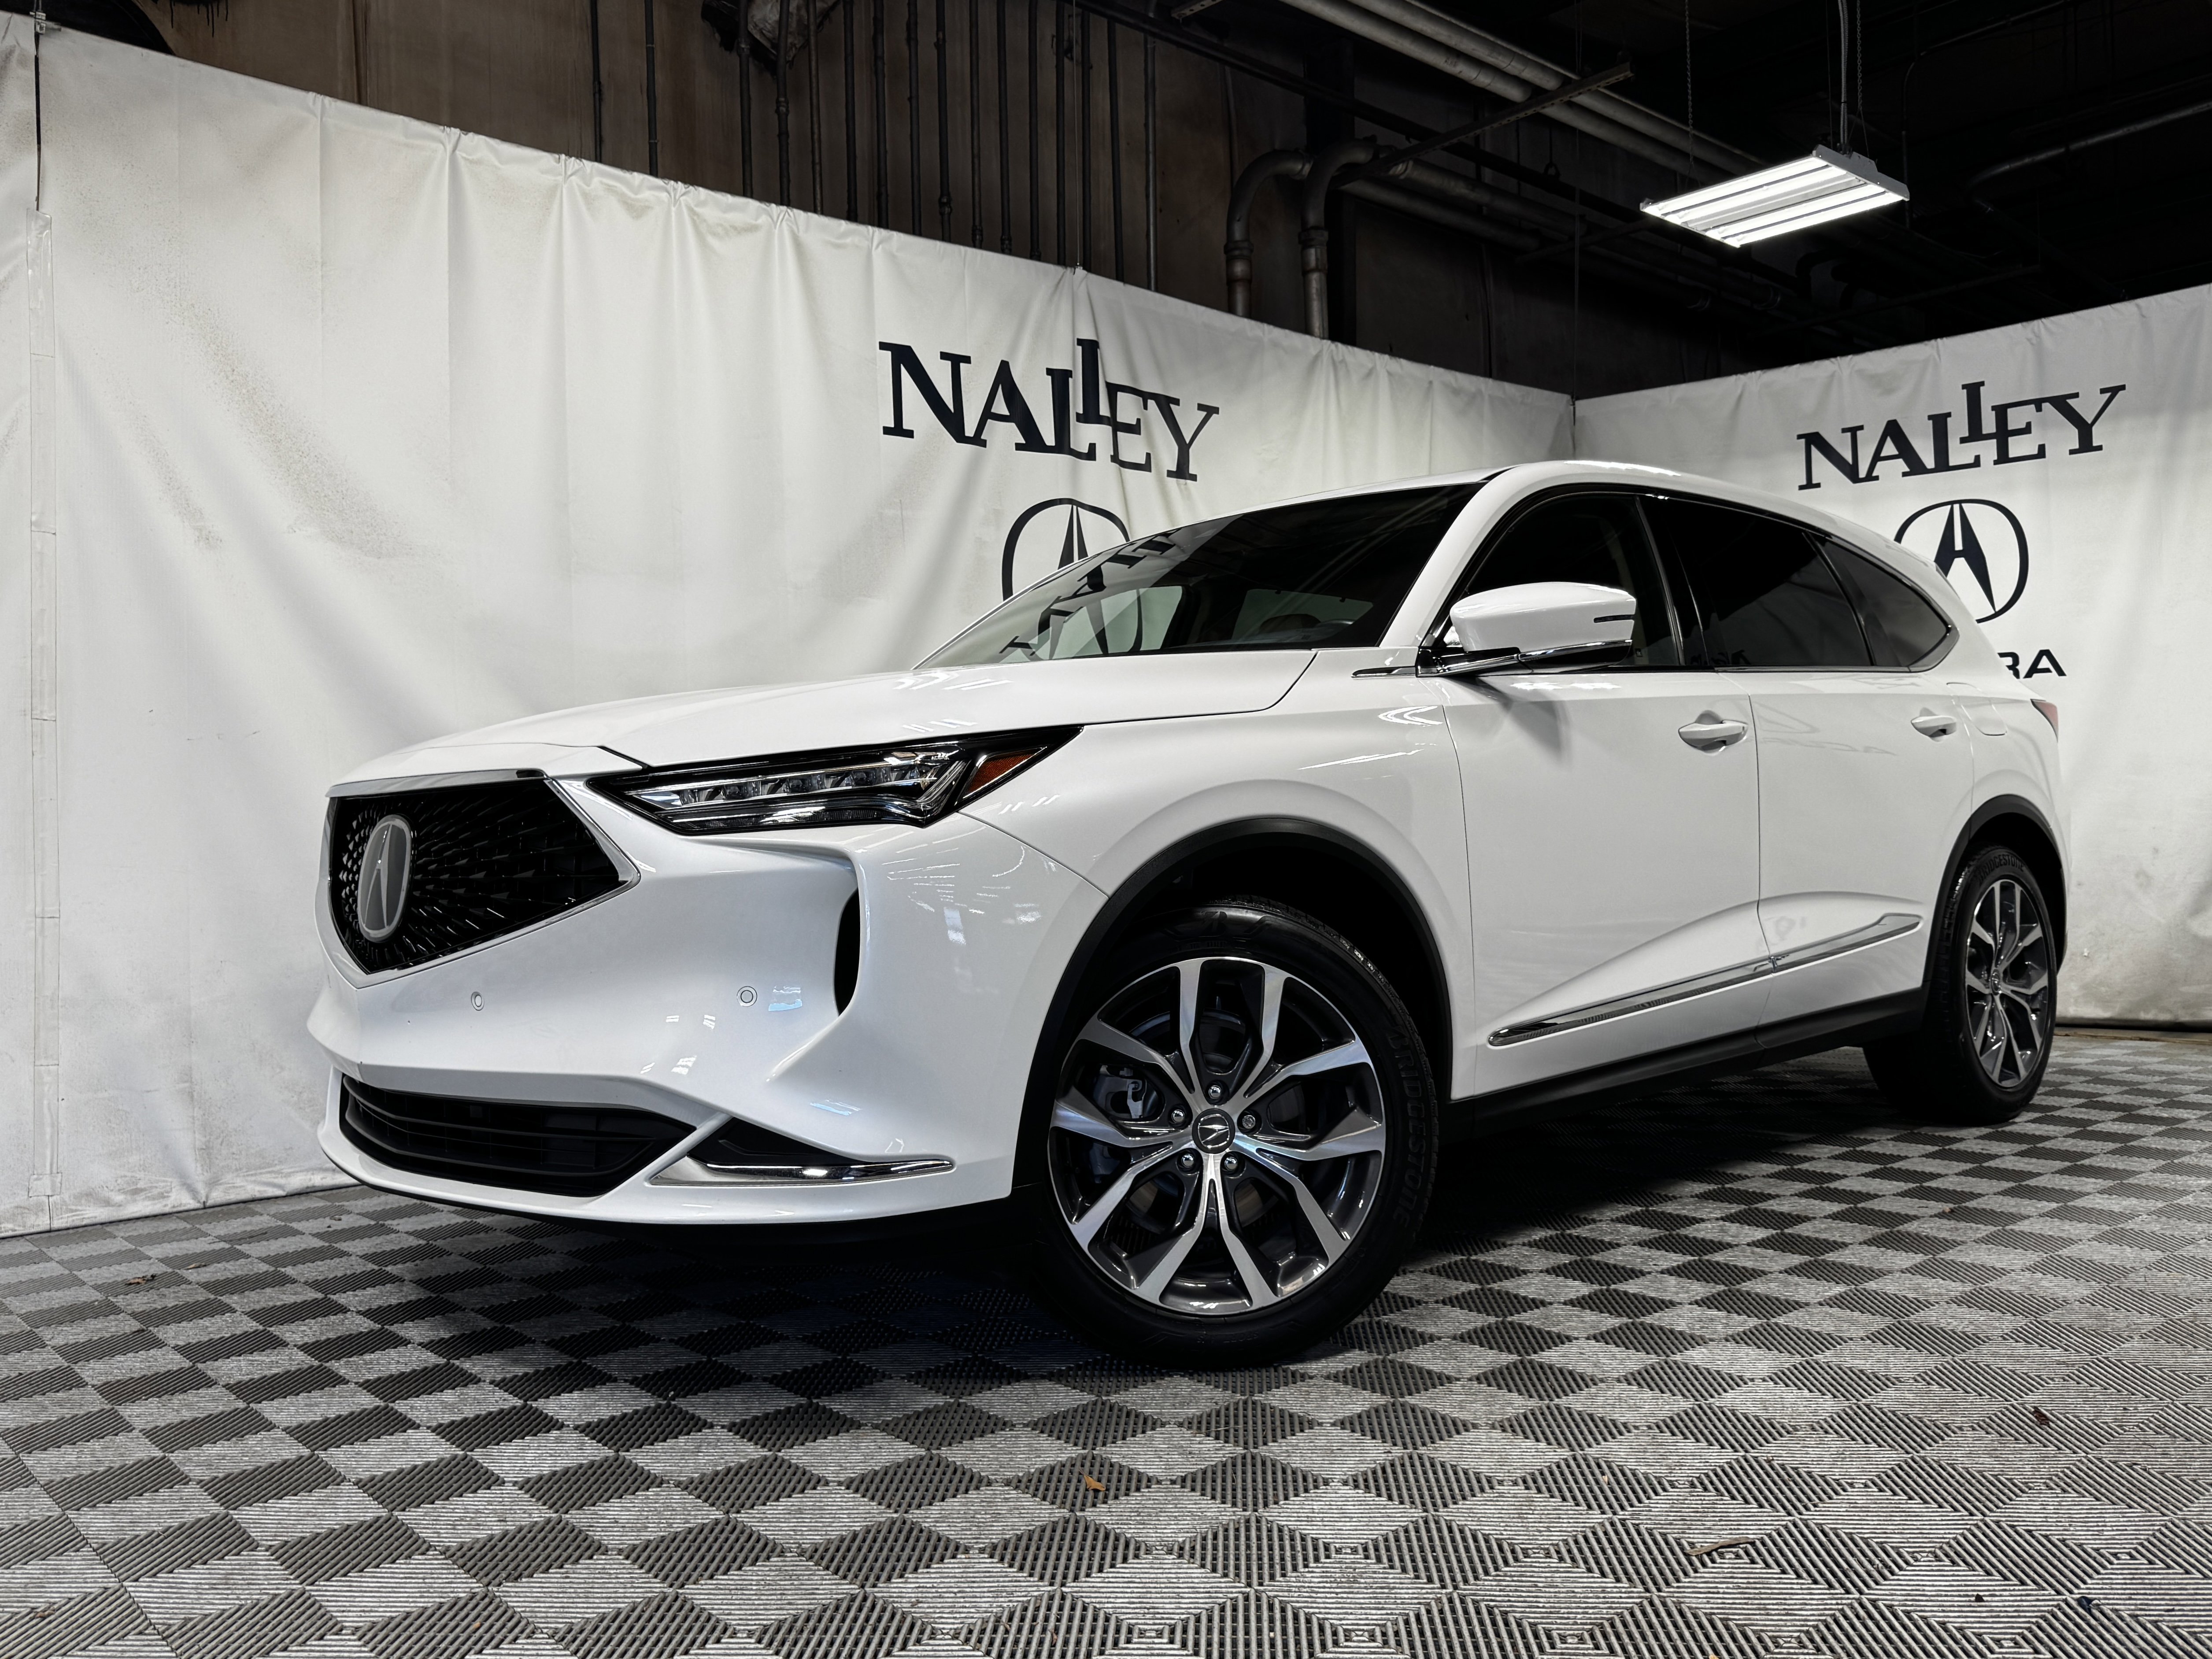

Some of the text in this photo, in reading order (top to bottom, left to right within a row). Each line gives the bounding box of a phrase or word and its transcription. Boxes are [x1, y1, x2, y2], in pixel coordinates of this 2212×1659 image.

[879, 338, 1220, 482] NALLEY
[1796, 381, 2126, 490] NALLEY
[1978, 854, 2025, 885] BRIDGESTONE
[1386, 1025, 1426, 1229] BRIDGESTONE
